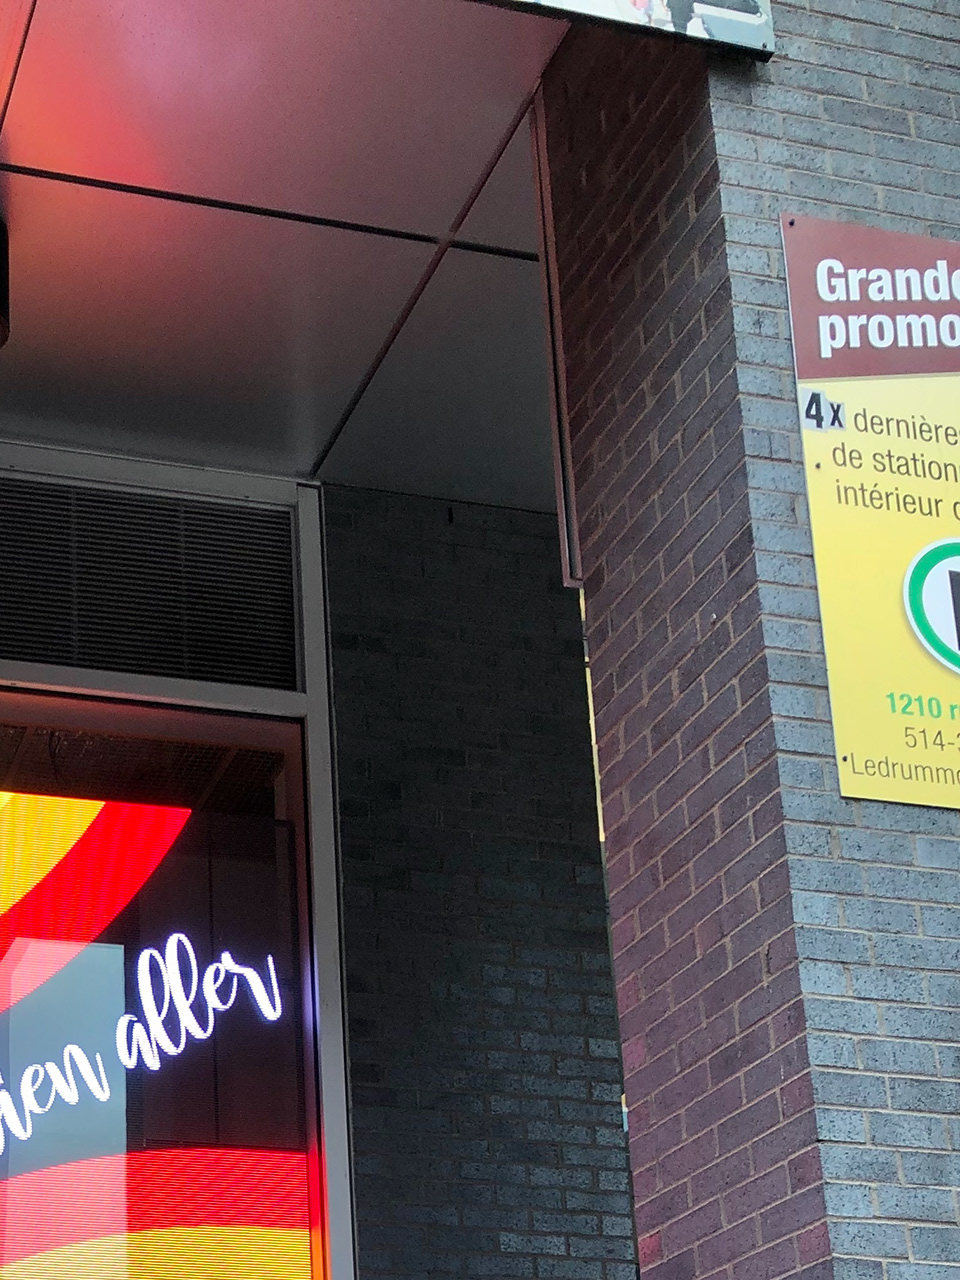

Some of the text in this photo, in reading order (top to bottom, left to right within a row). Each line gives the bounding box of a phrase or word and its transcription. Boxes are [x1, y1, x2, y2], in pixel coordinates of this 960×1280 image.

[818, 313, 960, 358] promo
[853, 407, 960, 447] dernière
[832, 442, 960, 483] de station
[835, 478, 943, 518] intérieur
[886, 692, 942, 719] 1210
[904, 726, 960, 752] 514-
[850, 752, 960, 786] Ledrumm
[115, 932, 282, 1071] aller
